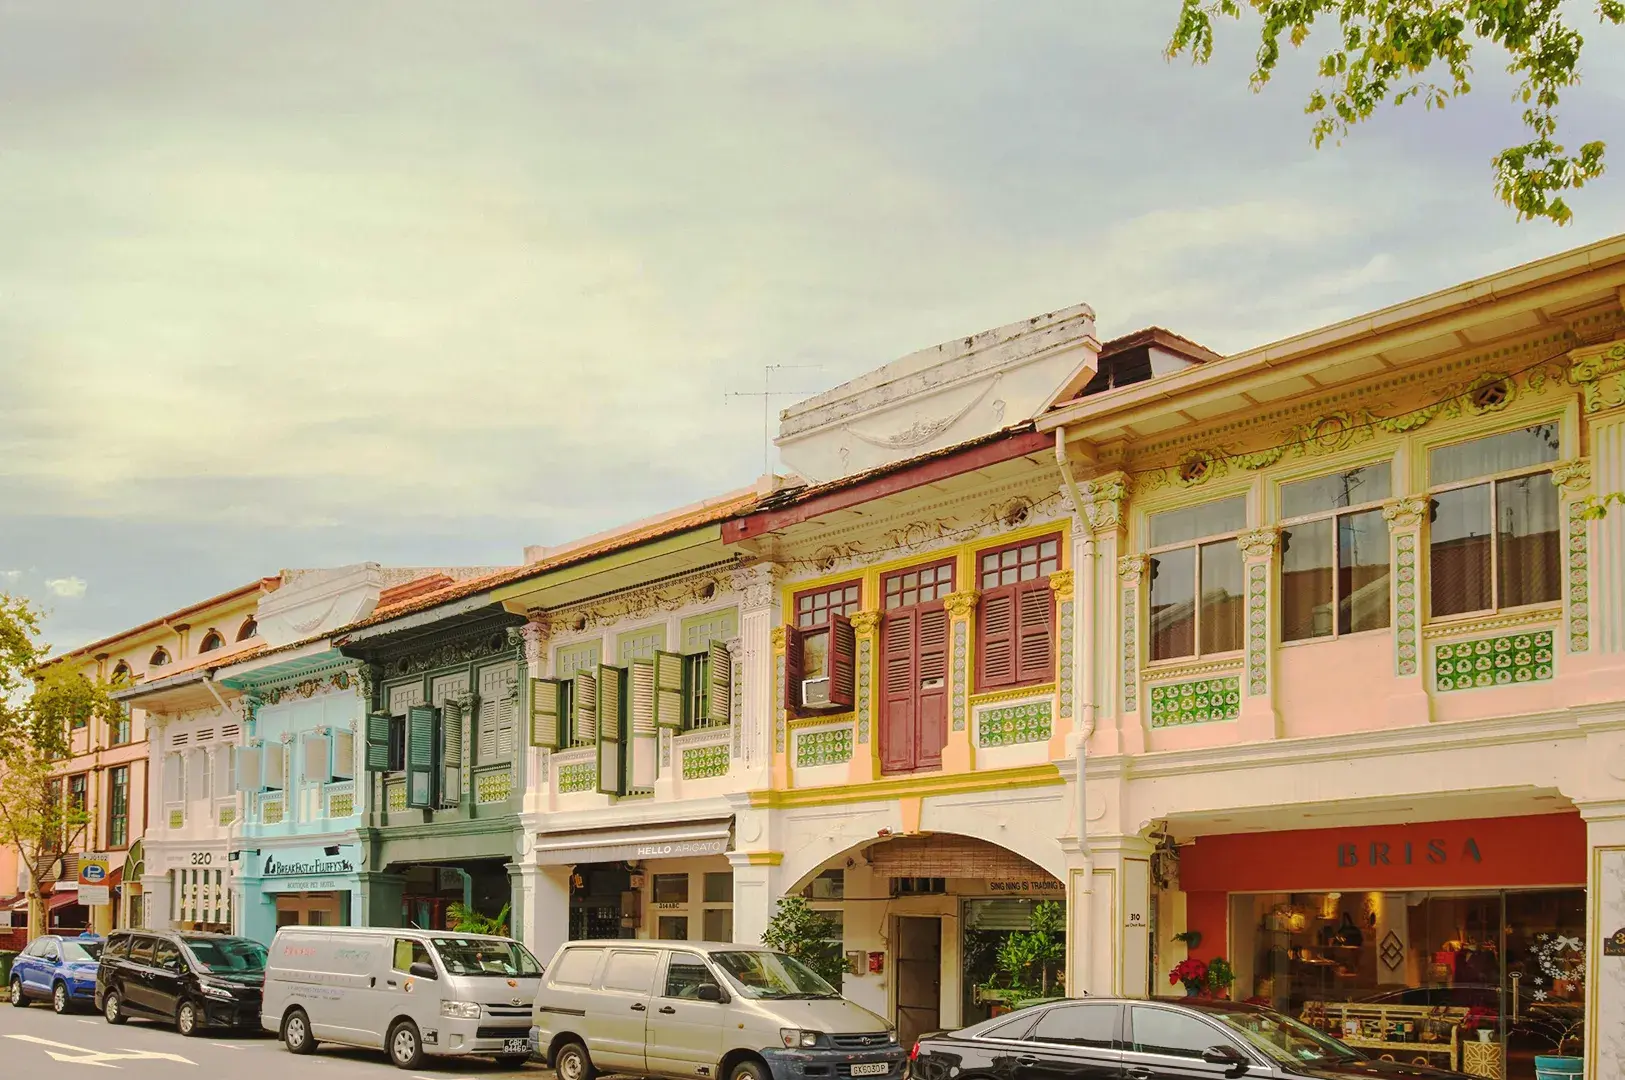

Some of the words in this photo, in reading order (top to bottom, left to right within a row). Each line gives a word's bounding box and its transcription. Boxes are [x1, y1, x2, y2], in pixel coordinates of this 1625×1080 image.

[637, 845, 672, 856] HELLO
[674, 841, 721, 853] ARIGATO
[1337, 837, 1482, 867] BRISA
[191, 852, 212, 865] 320
[990, 881, 1005, 891] SING
[1005, 881, 1021, 890] NING
[1031, 880, 1058, 890] TRADING
[1130, 913, 1141, 921] 310
[853, 1064, 886, 1075] GK6030P
